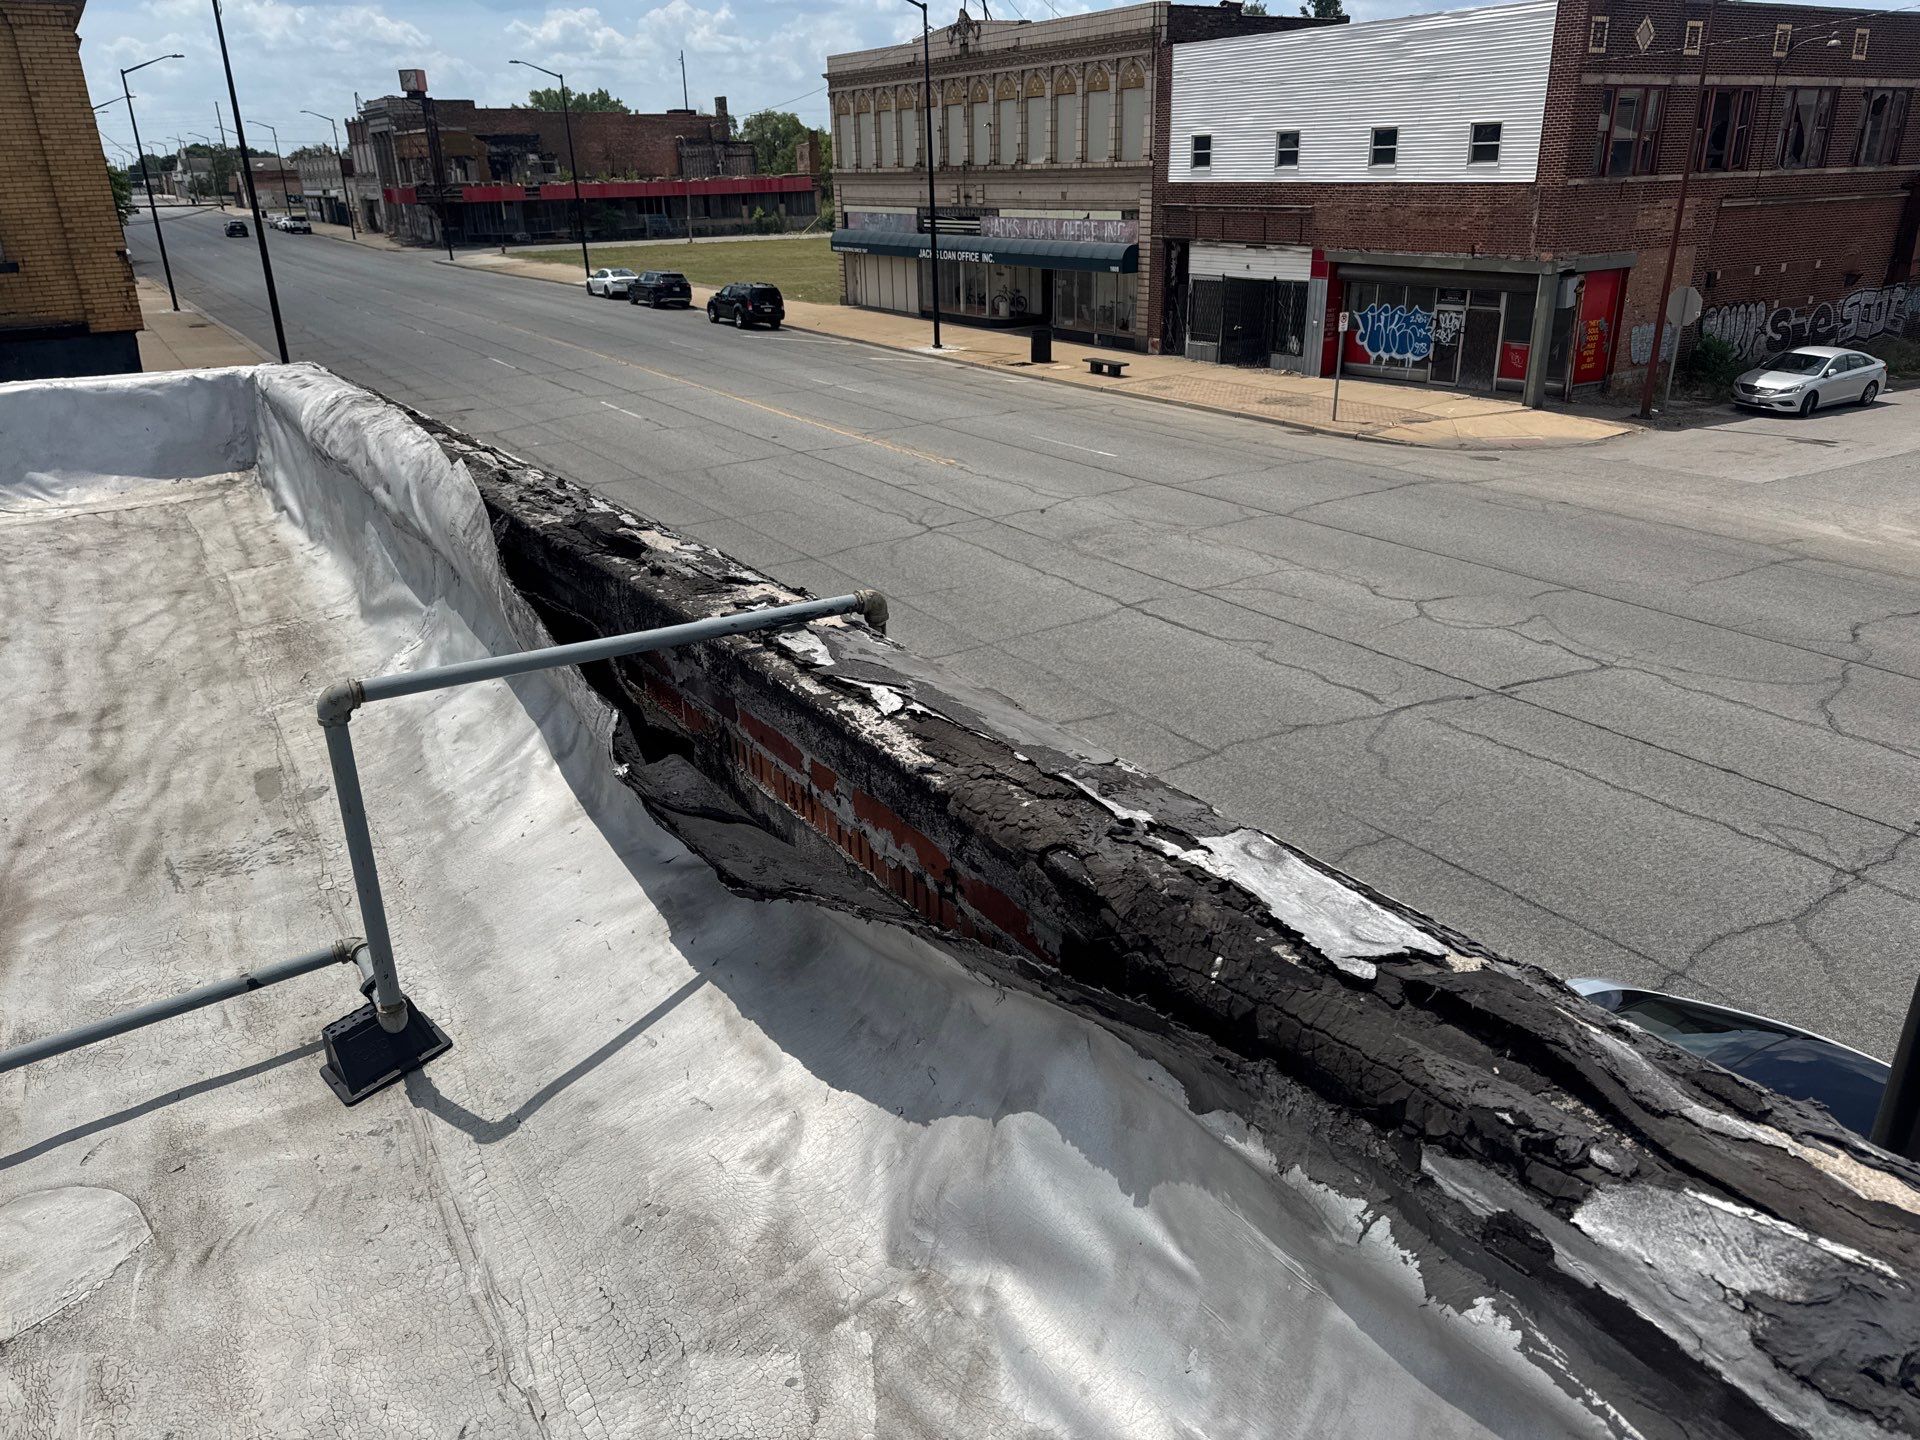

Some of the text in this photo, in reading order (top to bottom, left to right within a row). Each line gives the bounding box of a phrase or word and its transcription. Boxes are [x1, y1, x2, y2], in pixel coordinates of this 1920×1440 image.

[1027, 219, 1057, 240] LOAN
[1062, 221, 1099, 242] OFFICE
[940, 250, 956, 261] LOAN
[957, 251, 979, 263] OFFICE
[982, 253, 995, 264] INC.
